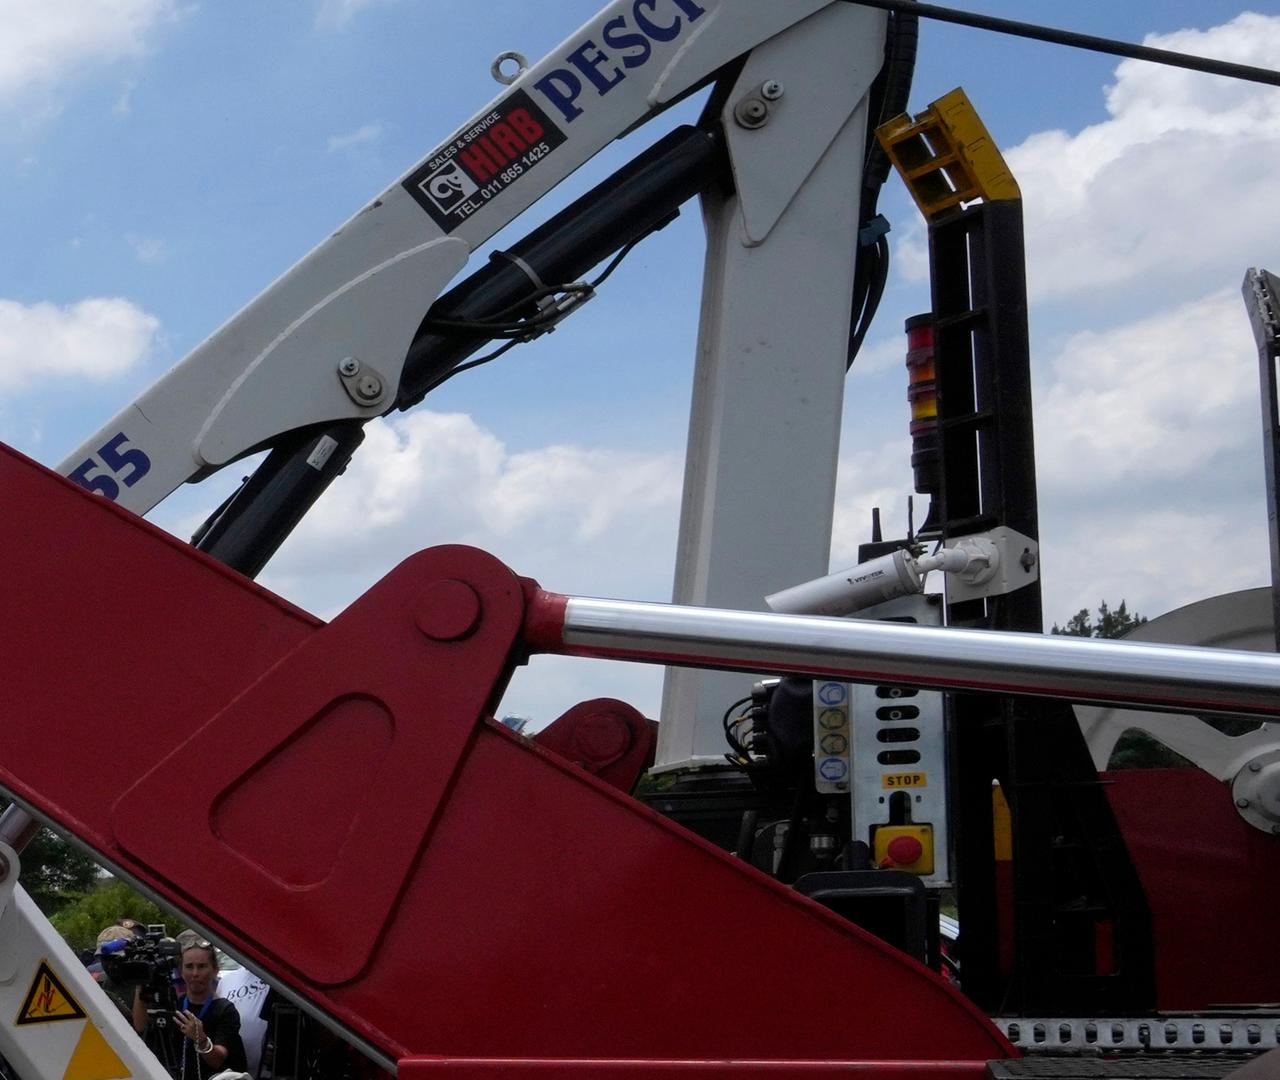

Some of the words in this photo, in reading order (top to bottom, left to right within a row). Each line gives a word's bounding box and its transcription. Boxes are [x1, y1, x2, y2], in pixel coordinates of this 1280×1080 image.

[429, 146, 458, 170] SALES
[457, 139, 465, 148] &
[464, 111, 501, 143] SERVICE
[458, 107, 544, 182] HIAB
[454, 196, 483, 219] TEL.
[481, 180, 502, 200] 011
[500, 163, 523, 183] 865
[522, 142, 550, 167] 1425
[887, 775, 921, 786] STOP
[227, 981, 266, 1000] BOSS
